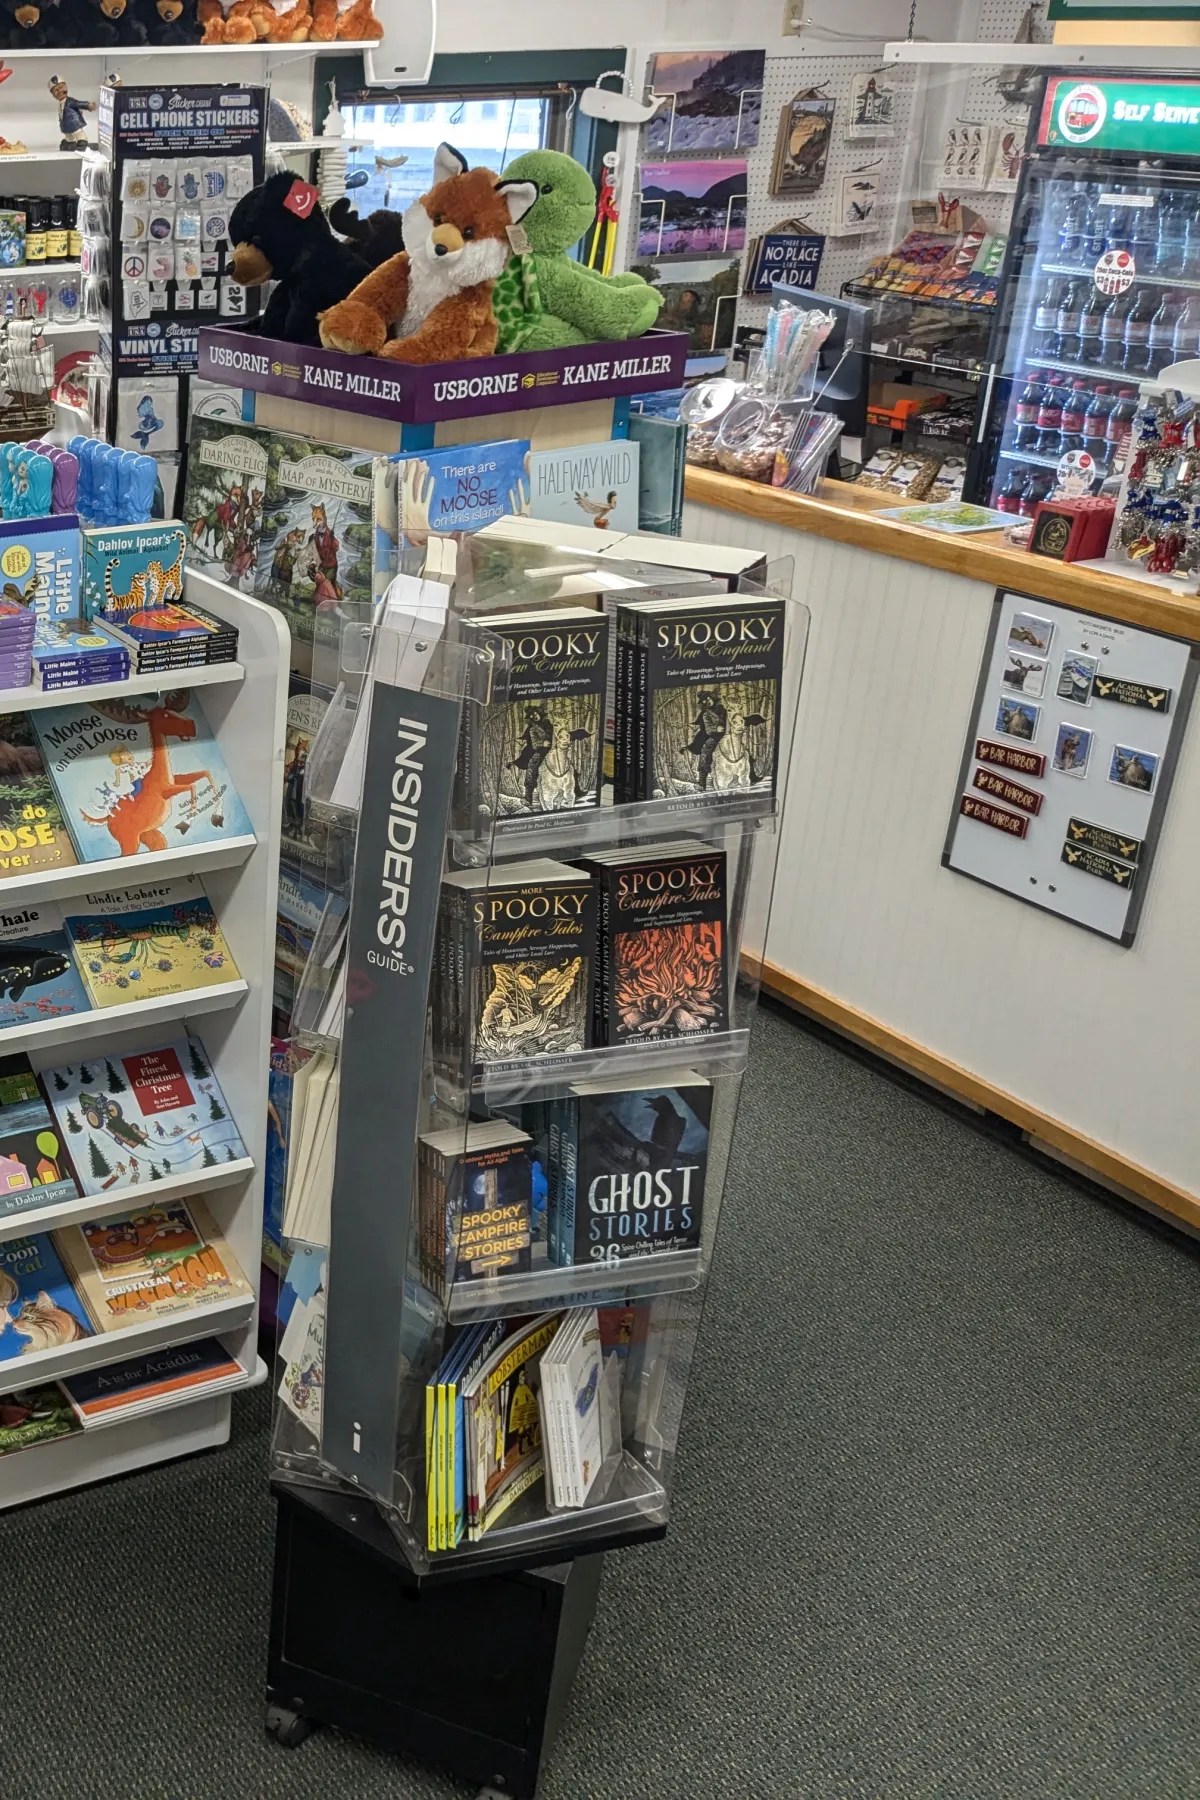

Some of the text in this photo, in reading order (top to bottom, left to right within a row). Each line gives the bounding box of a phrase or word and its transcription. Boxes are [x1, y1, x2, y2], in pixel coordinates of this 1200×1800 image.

[121, 110, 258, 128] CELL PHONE STICKERS
[1092, 220, 1105, 252] smart
[765, 247, 819, 261] NO PLACE
[760, 269, 812, 285] ACADIA
[120, 339, 167, 354] VINYL
[209, 346, 401, 402] USBORNE KANE MILLER
[434, 355, 671, 402] USBORNE KANE MILLER
[441, 462, 496, 479] There are
[538, 452, 632, 496] HALFWAY WILD
[282, 469, 368, 500] MAP OF MYSTERY
[457, 476, 481, 492] NO
[440, 489, 497, 514] MOOSE
[433, 504, 504, 529] on this island!
[98, 533, 171, 553] Dahlov Ipcar's
[55, 559, 72, 615] Little
[657, 616, 777, 648] SPOOKY
[482, 631, 600, 662] SPOOKY
[663, 637, 777, 662] New England
[531, 651, 601, 678] England
[1112, 687, 1147, 700] NATIONAL
[1117, 682, 1143, 693] ACADIA
[43, 714, 104, 749] Moose
[55, 726, 139, 774] on the Loose
[989, 747, 1036, 770] BAR HARBOR
[988, 777, 1034, 808] BAR HARBOR
[23, 805, 47, 820] do
[974, 804, 1020, 832] BAR HARBOR
[376, 716, 429, 961] INSIDERS'
[520, 886, 544, 895] MORE
[618, 862, 720, 896] SPOOKY
[86, 886, 171, 905] Lindie Lobster
[616, 883, 721, 914] Campfire Tales
[473, 894, 588, 923] SPOOKY
[478, 917, 584, 946] Campfire Tales
[140, 1064, 168, 1076] Finest
[141, 1056, 159, 1066] The
[135, 1072, 181, 1087] Christmas
[151, 1084, 172, 1094] Tree
[588, 1165, 700, 1214] GHOST
[461, 1206, 521, 1229] SPOOKY
[589, 1206, 693, 1241] STORIES
[453, 1219, 528, 1246] CAMPFIRE
[464, 1236, 524, 1260] STORIES
[589, 1243, 620, 1271] 36
[14, 1259, 44, 1276] Cat
[105, 1274, 172, 1298] CRUSTACEAN
[489, 1318, 561, 1391] LOBSTERMAN
